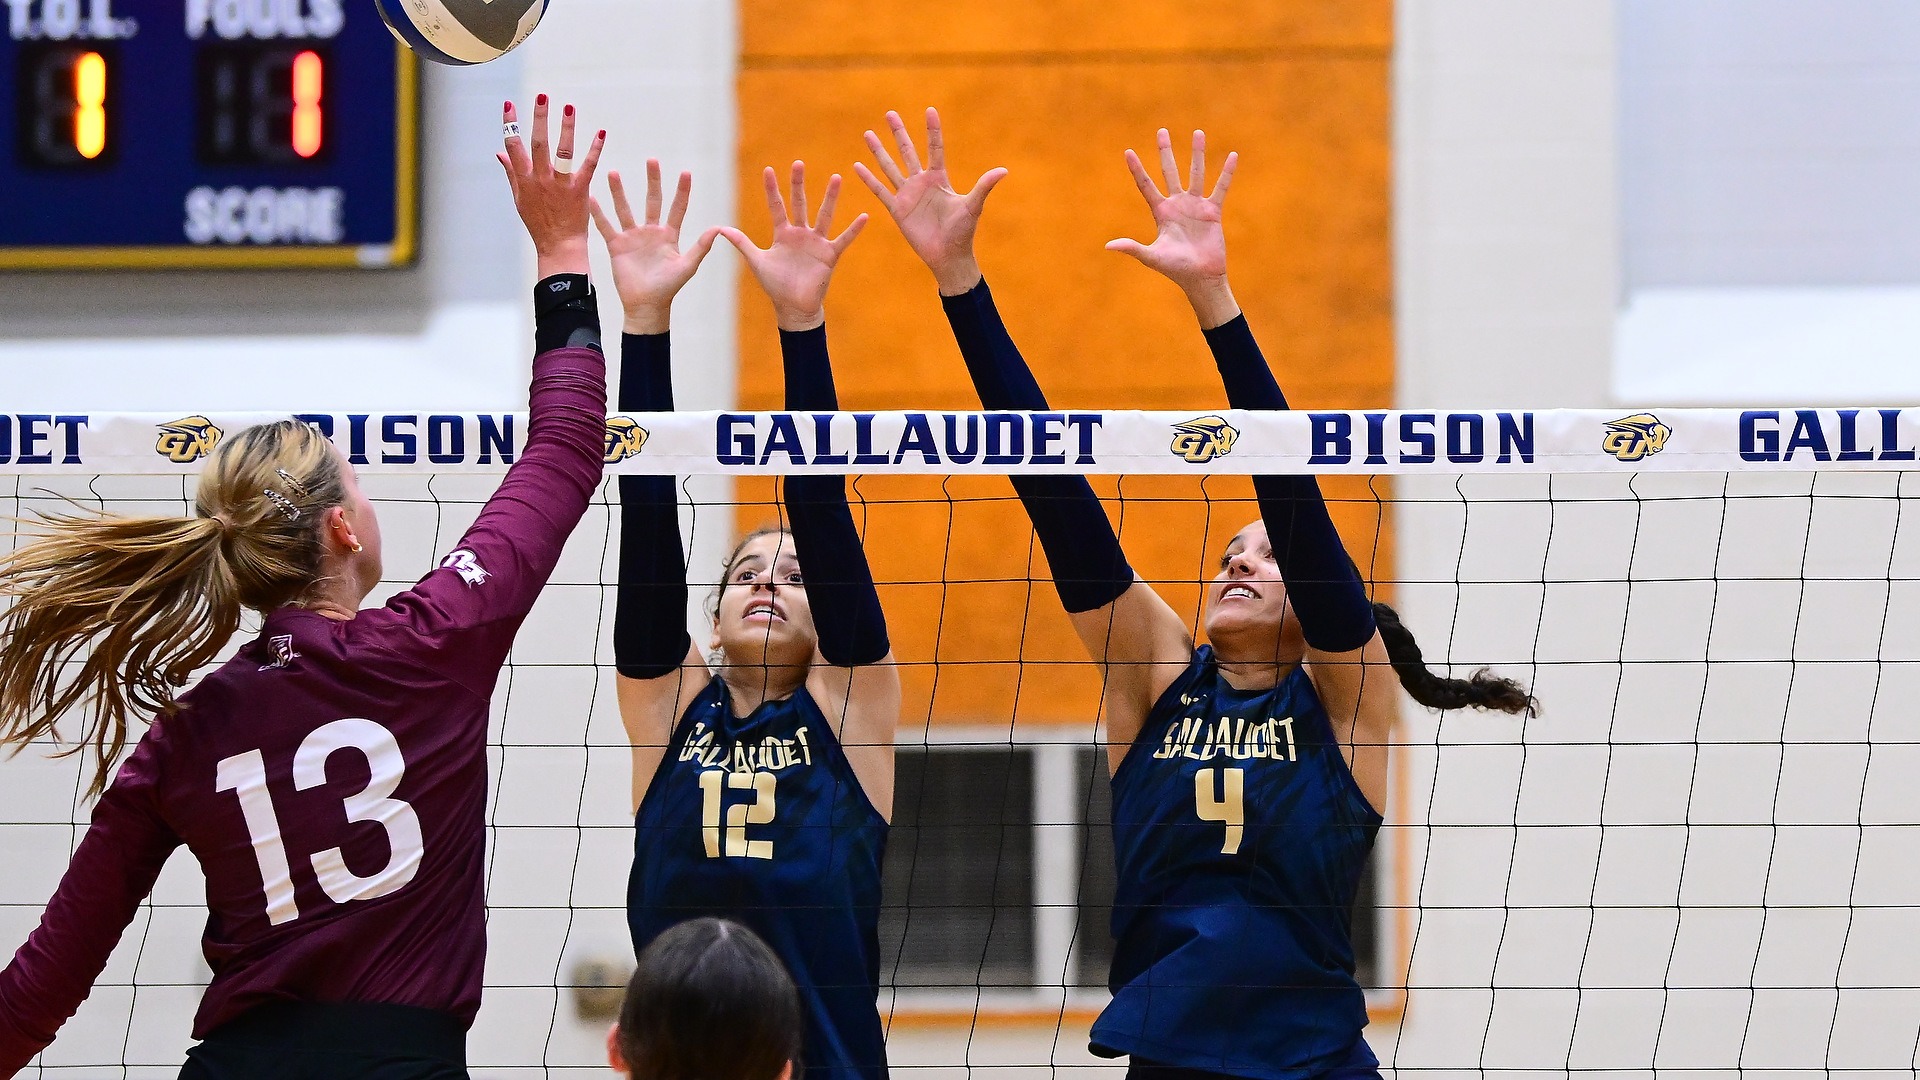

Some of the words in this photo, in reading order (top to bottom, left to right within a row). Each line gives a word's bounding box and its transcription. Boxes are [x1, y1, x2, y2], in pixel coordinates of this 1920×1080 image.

[185, 0, 346, 40] FOULS
[183, 185, 346, 244] SCORE
[715, 413, 1103, 466] GALLAUDET
[1306, 412, 1534, 465] BISON
[1738, 409, 1920, 462] GALL
[678, 722, 813, 774] GALLAUDET
[1152, 716, 1297, 763] GALLAUDET
[216, 717, 424, 927] 13
[698, 769, 777, 860] 12
[1194, 768, 1245, 855] 4
